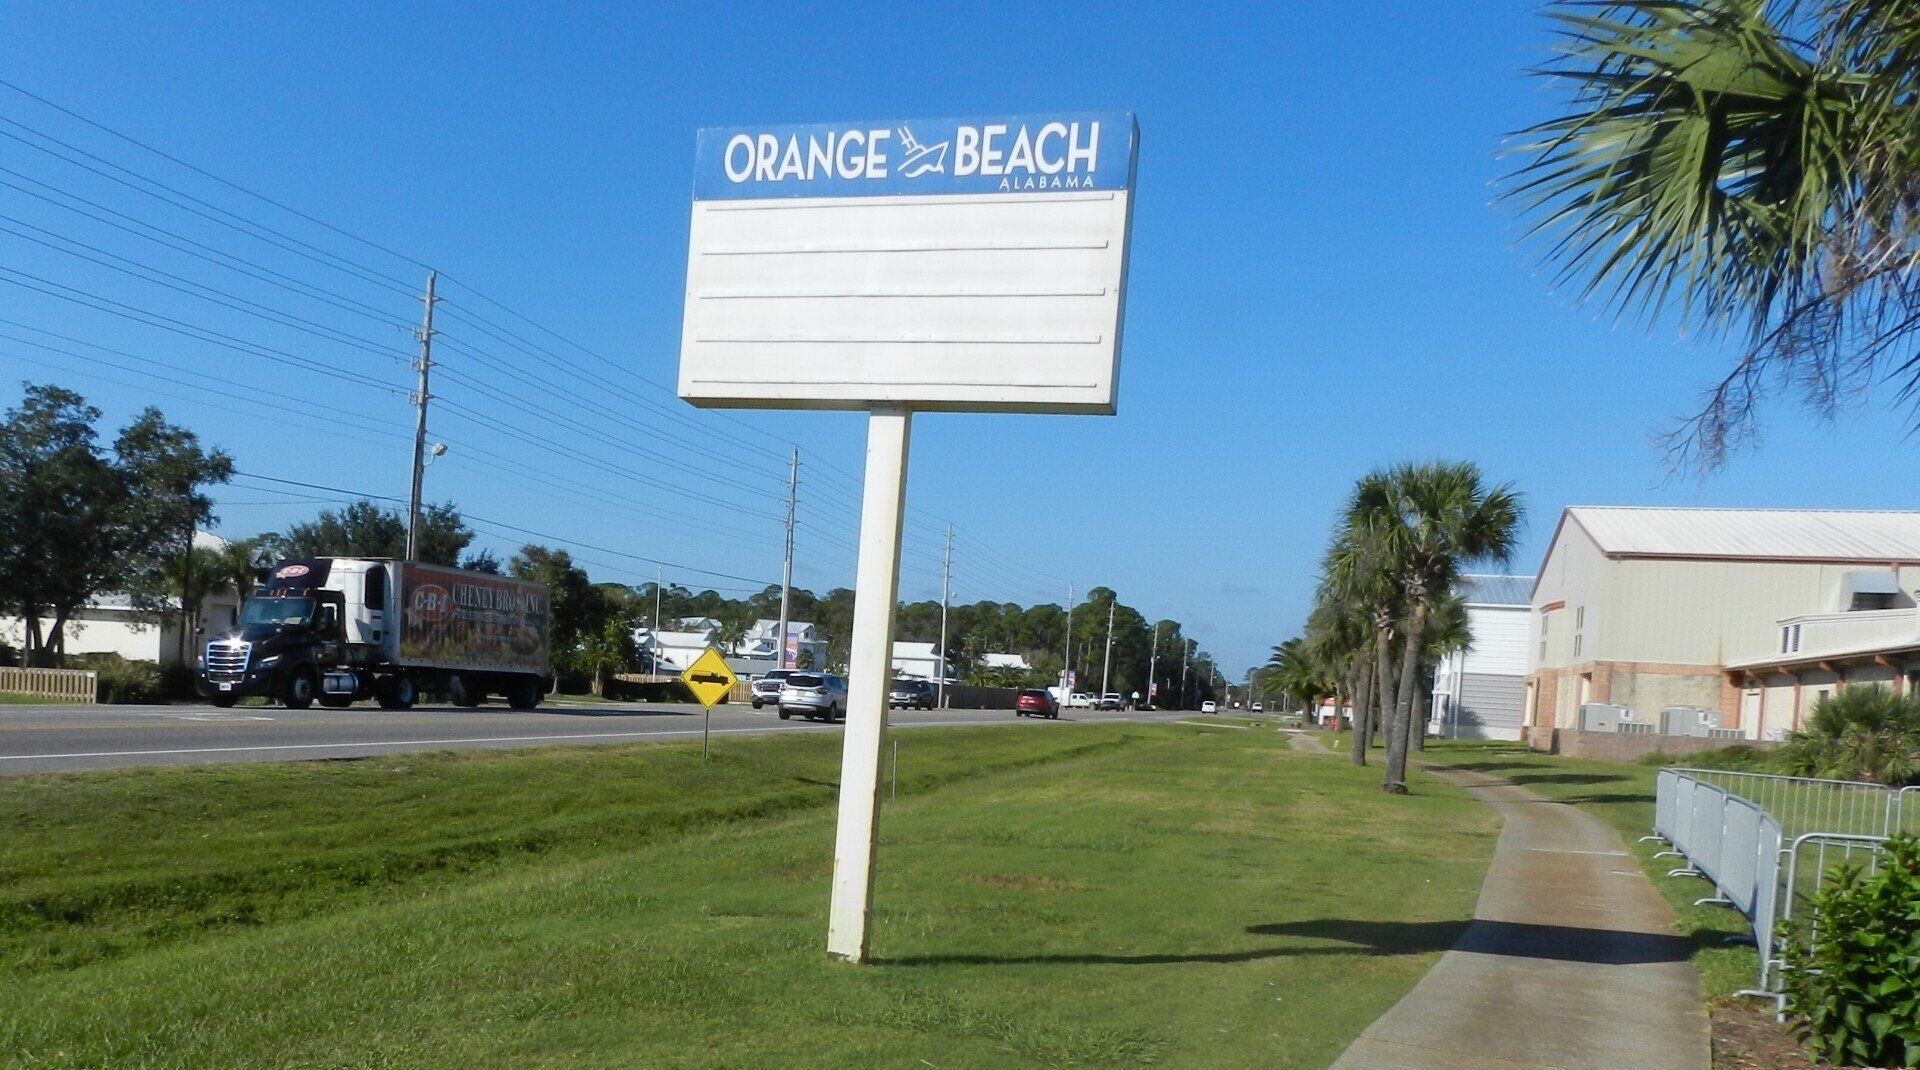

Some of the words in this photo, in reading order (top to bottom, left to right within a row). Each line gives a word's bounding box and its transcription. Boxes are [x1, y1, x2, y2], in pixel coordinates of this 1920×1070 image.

[724, 129, 890, 183] ORANGE
[953, 121, 1099, 176] BEACH
[999, 175, 1094, 190] ALABAMA
[452, 583, 495, 609] CHENEY
